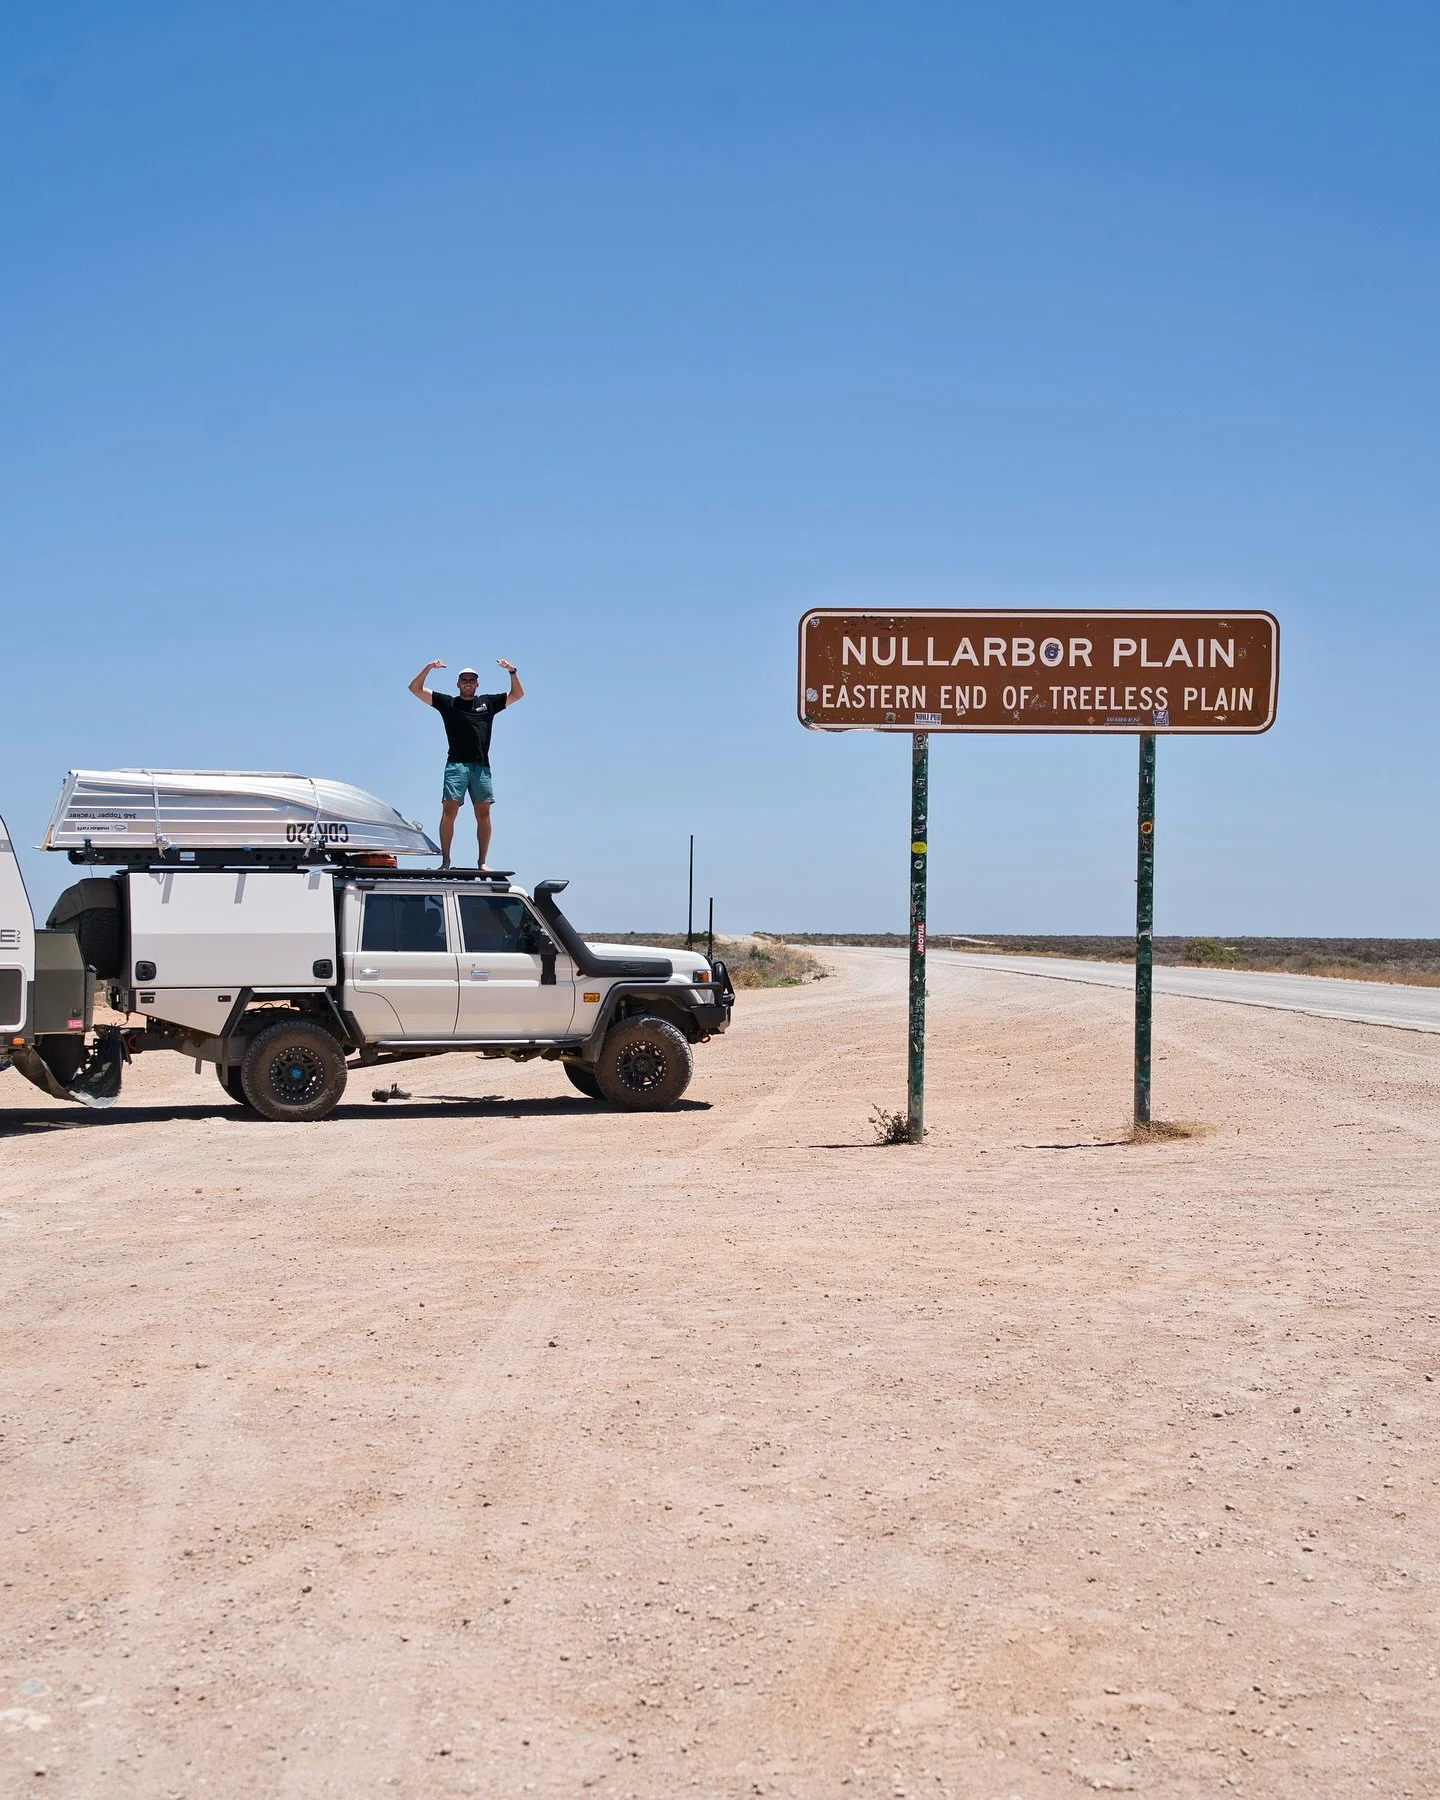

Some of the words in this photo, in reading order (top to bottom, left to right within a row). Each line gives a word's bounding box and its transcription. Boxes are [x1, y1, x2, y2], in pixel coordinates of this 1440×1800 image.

[842, 636, 1093, 667] NULLARBOR
[1113, 638, 1235, 668] PLAIN
[822, 684, 926, 709] EASTERN
[940, 685, 987, 709] END
[1002, 685, 1033, 710] OF
[1049, 686, 1168, 712] TREELESS
[1183, 687, 1254, 711] PLAIN
[917, 923, 925, 952] MOTUL
